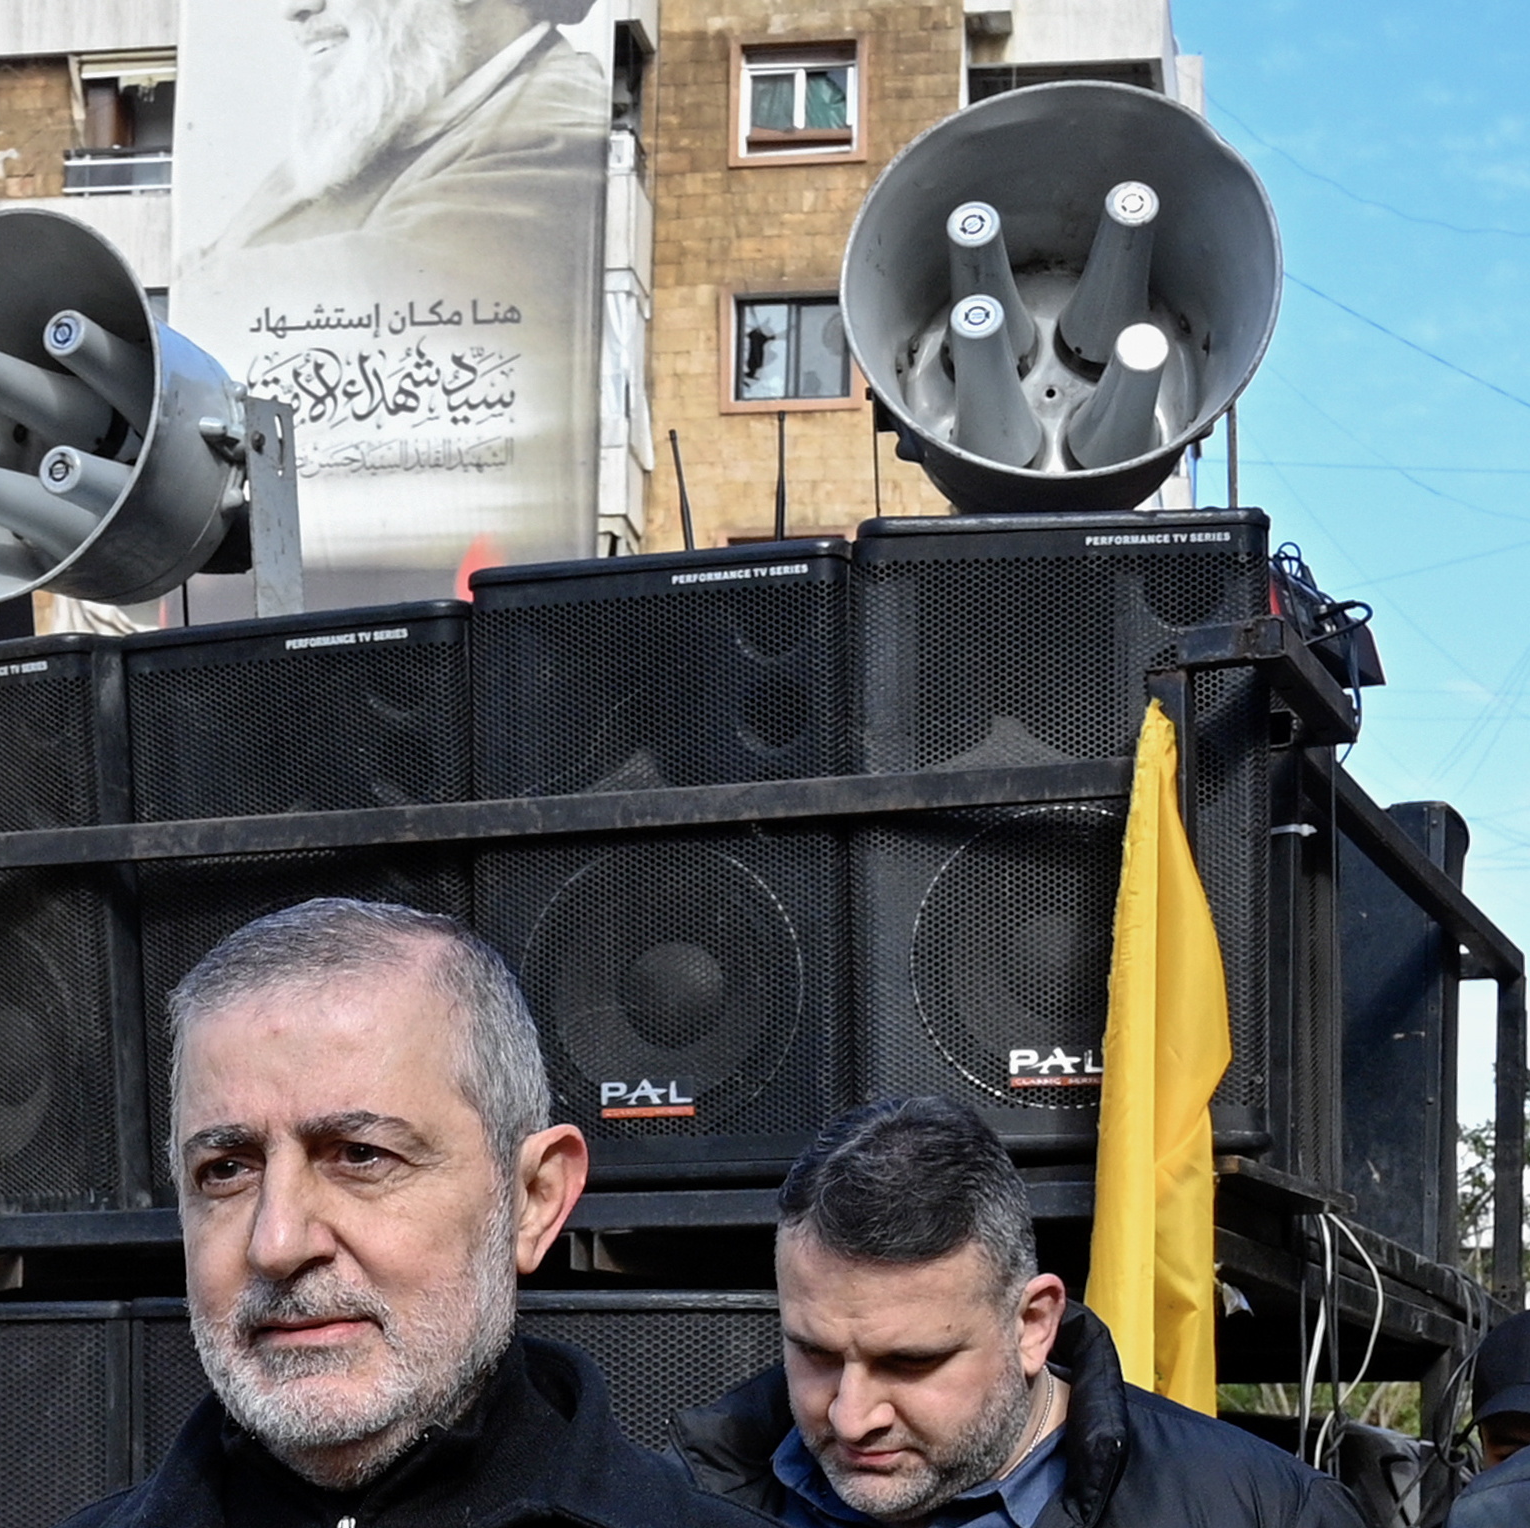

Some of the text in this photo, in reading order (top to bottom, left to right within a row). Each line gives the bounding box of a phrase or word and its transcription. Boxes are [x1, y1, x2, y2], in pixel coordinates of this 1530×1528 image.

[250, 299, 522, 339] هنا مكان إستشهاد
[1085, 531, 1231, 546] PERFORMANCE TV SERIES
[671, 563, 809, 585] PERFORMANCE TV SERIES
[285, 628, 408, 649] PERFORMANCE TV SERIES
[1009, 1046, 1104, 1075] PAL
[600, 1078, 694, 1106] PAL
